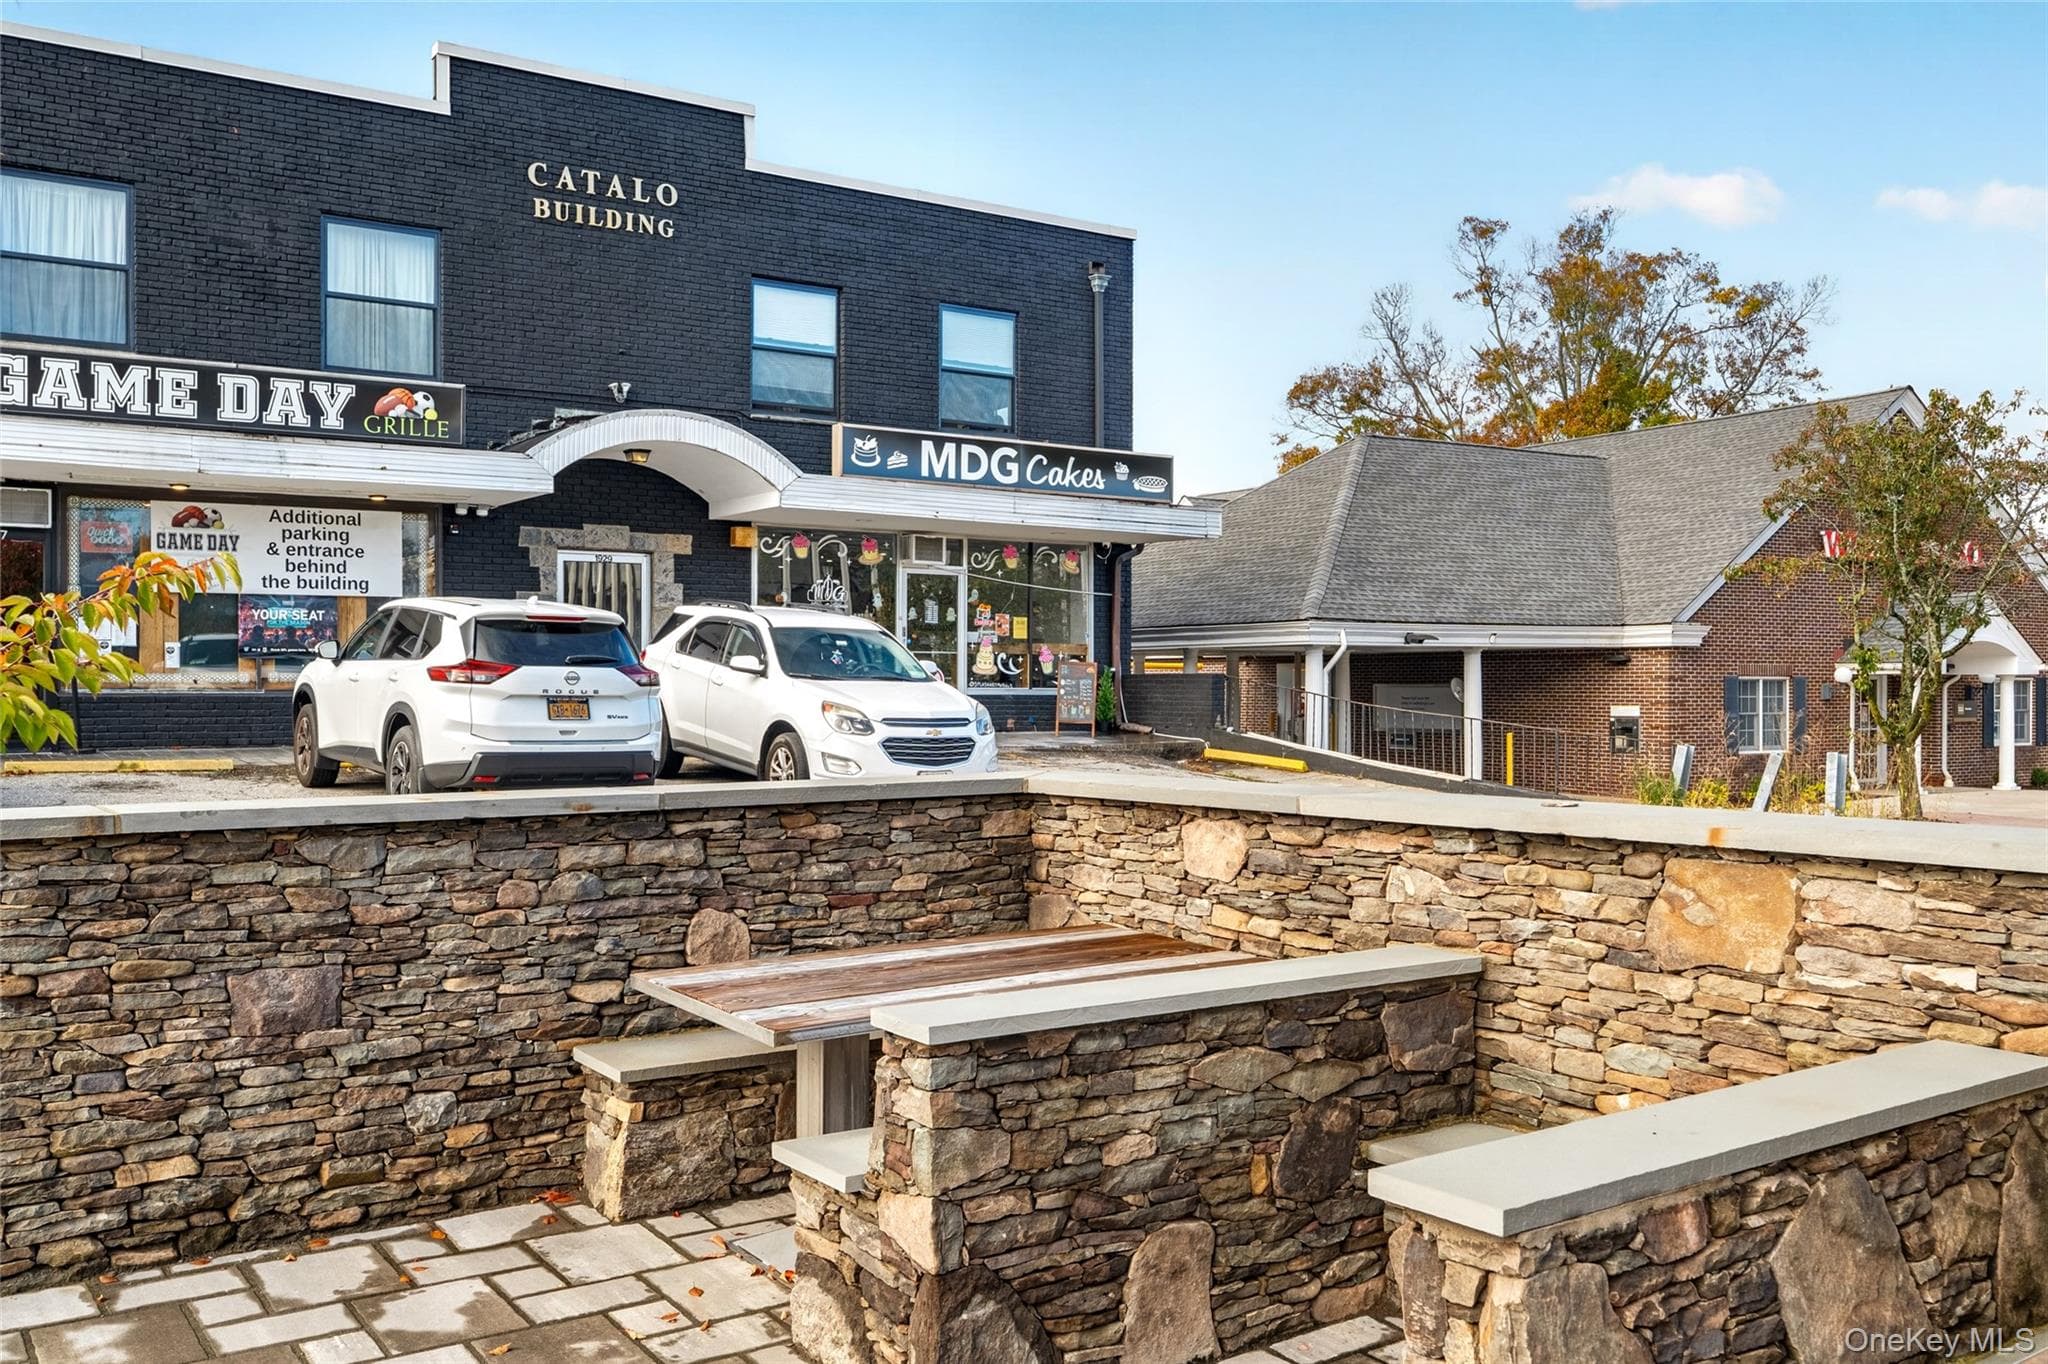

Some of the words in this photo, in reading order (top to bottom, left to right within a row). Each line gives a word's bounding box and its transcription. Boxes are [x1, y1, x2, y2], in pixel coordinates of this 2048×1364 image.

[527, 162, 678, 207] CATALO
[533, 197, 675, 238] BUILDING
[0, 354, 198, 419] GAME
[217, 373, 356, 430] DAY
[363, 415, 449, 439] GRILLE
[920, 440, 1018, 484] MDG
[1025, 454, 1106, 490] Cakes
[268, 509, 361, 526] Additional
[156, 532, 203, 551] GAME
[207, 534, 240, 552] DAY
[282, 526, 350, 545] parking
[266, 542, 280, 556] &
[286, 544, 365, 558] entrance
[285, 558, 347, 574] behind
[261, 574, 290, 589] the
[297, 575, 369, 594] building
[252, 609, 288, 621] YOUR
[292, 609, 325, 621] SEAT
